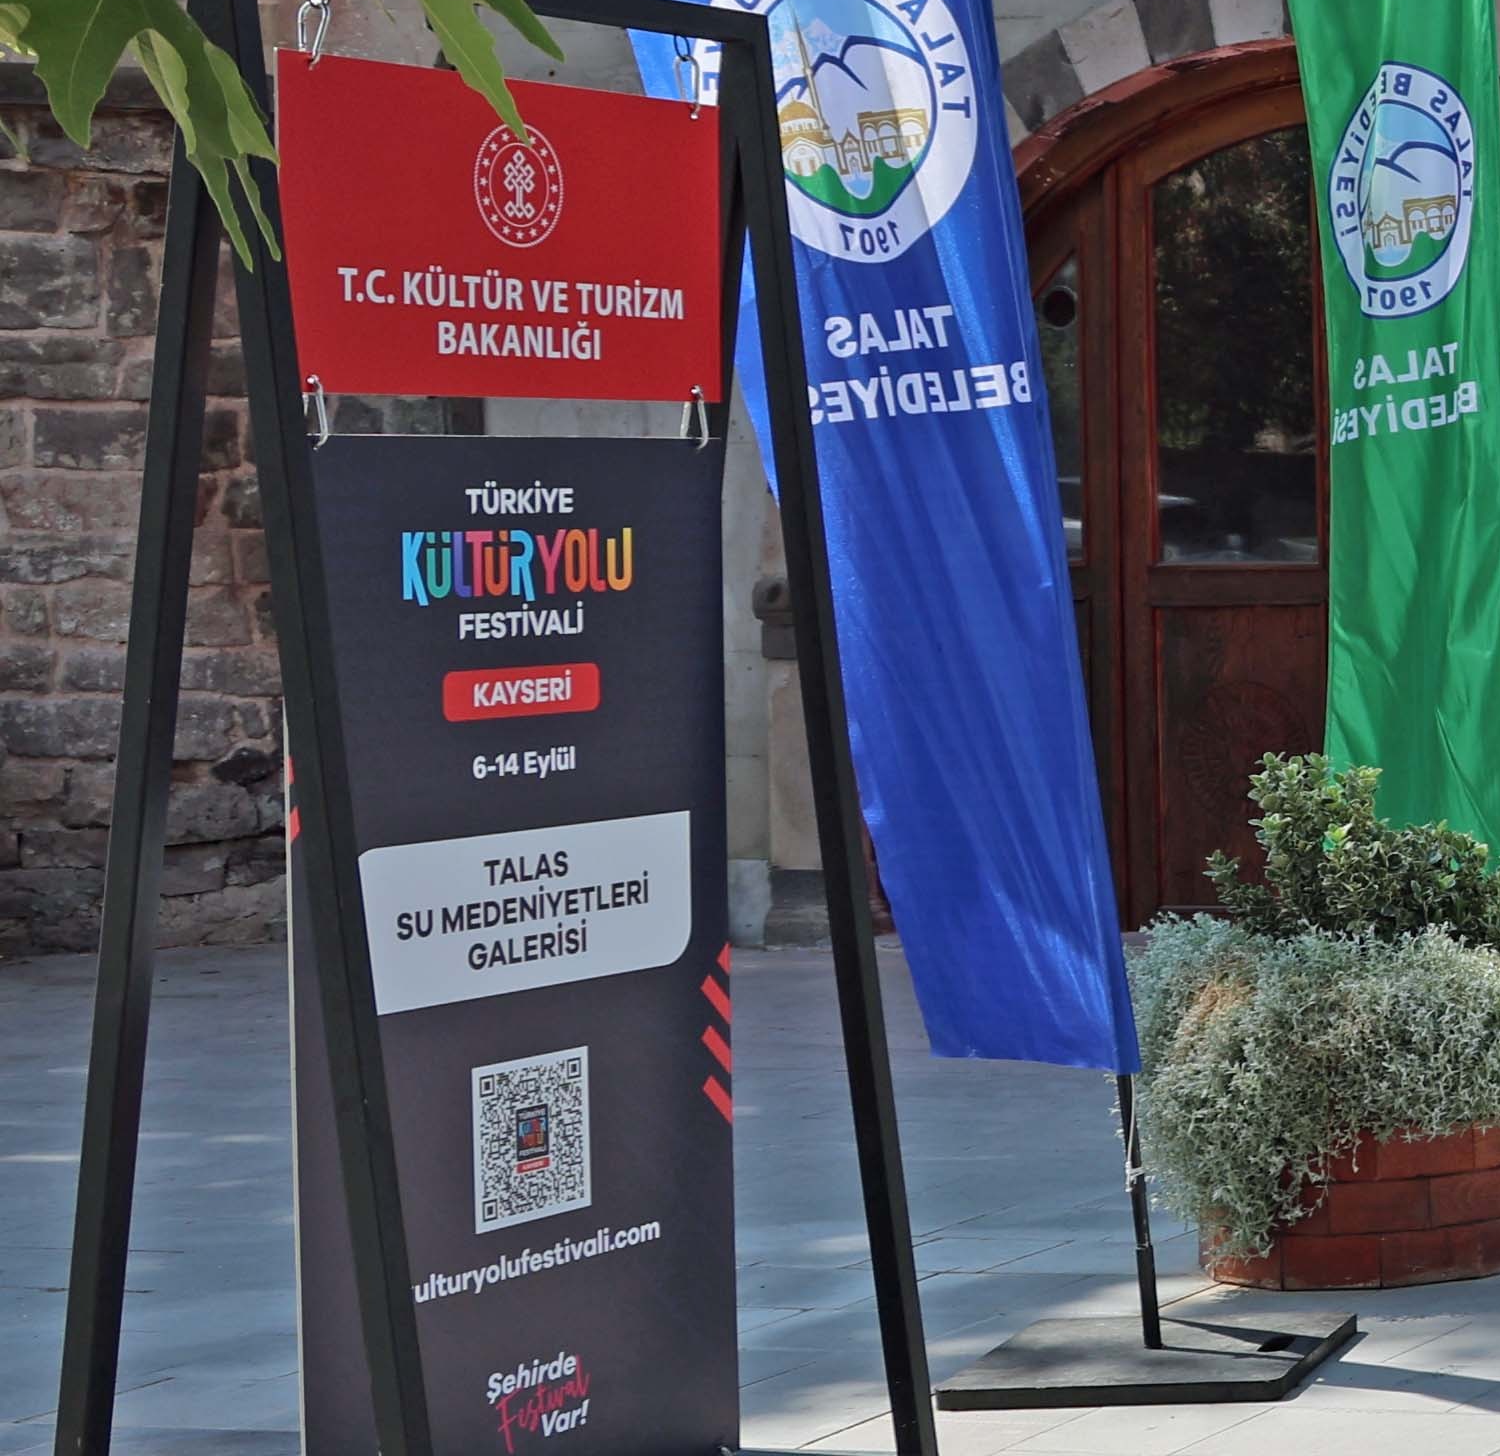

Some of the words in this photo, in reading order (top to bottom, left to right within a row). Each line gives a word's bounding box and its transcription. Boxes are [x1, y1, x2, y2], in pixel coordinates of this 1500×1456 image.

[338, 266, 395, 304] T.C.
[402, 265, 524, 312] KÜLTÜR
[532, 281, 569, 313] VE
[576, 278, 684, 320] TURİZM
[437, 320, 602, 361] BAKANLIĞI
[465, 479, 574, 516] TÜRKİYE
[401, 529, 535, 607] KÜLTÜR
[535, 527, 633, 596] YOLU
[459, 601, 584, 641] FESTİVALİ
[473, 671, 572, 709] KAYSERİ
[473, 751, 519, 780] 6-14
[525, 747, 576, 782] Eylül
[484, 851, 569, 888] TALAS
[397, 909, 435, 941] SU
[442, 871, 649, 935] MEDENİYETLERİ
[467, 919, 588, 972] GALERİSİ
[411, 1220, 660, 1304] ulturyolufestivali.com
[487, 1352, 578, 1404] Şehirde
[498, 1356, 590, 1453] Festival
[542, 1400, 589, 1438] Var!
